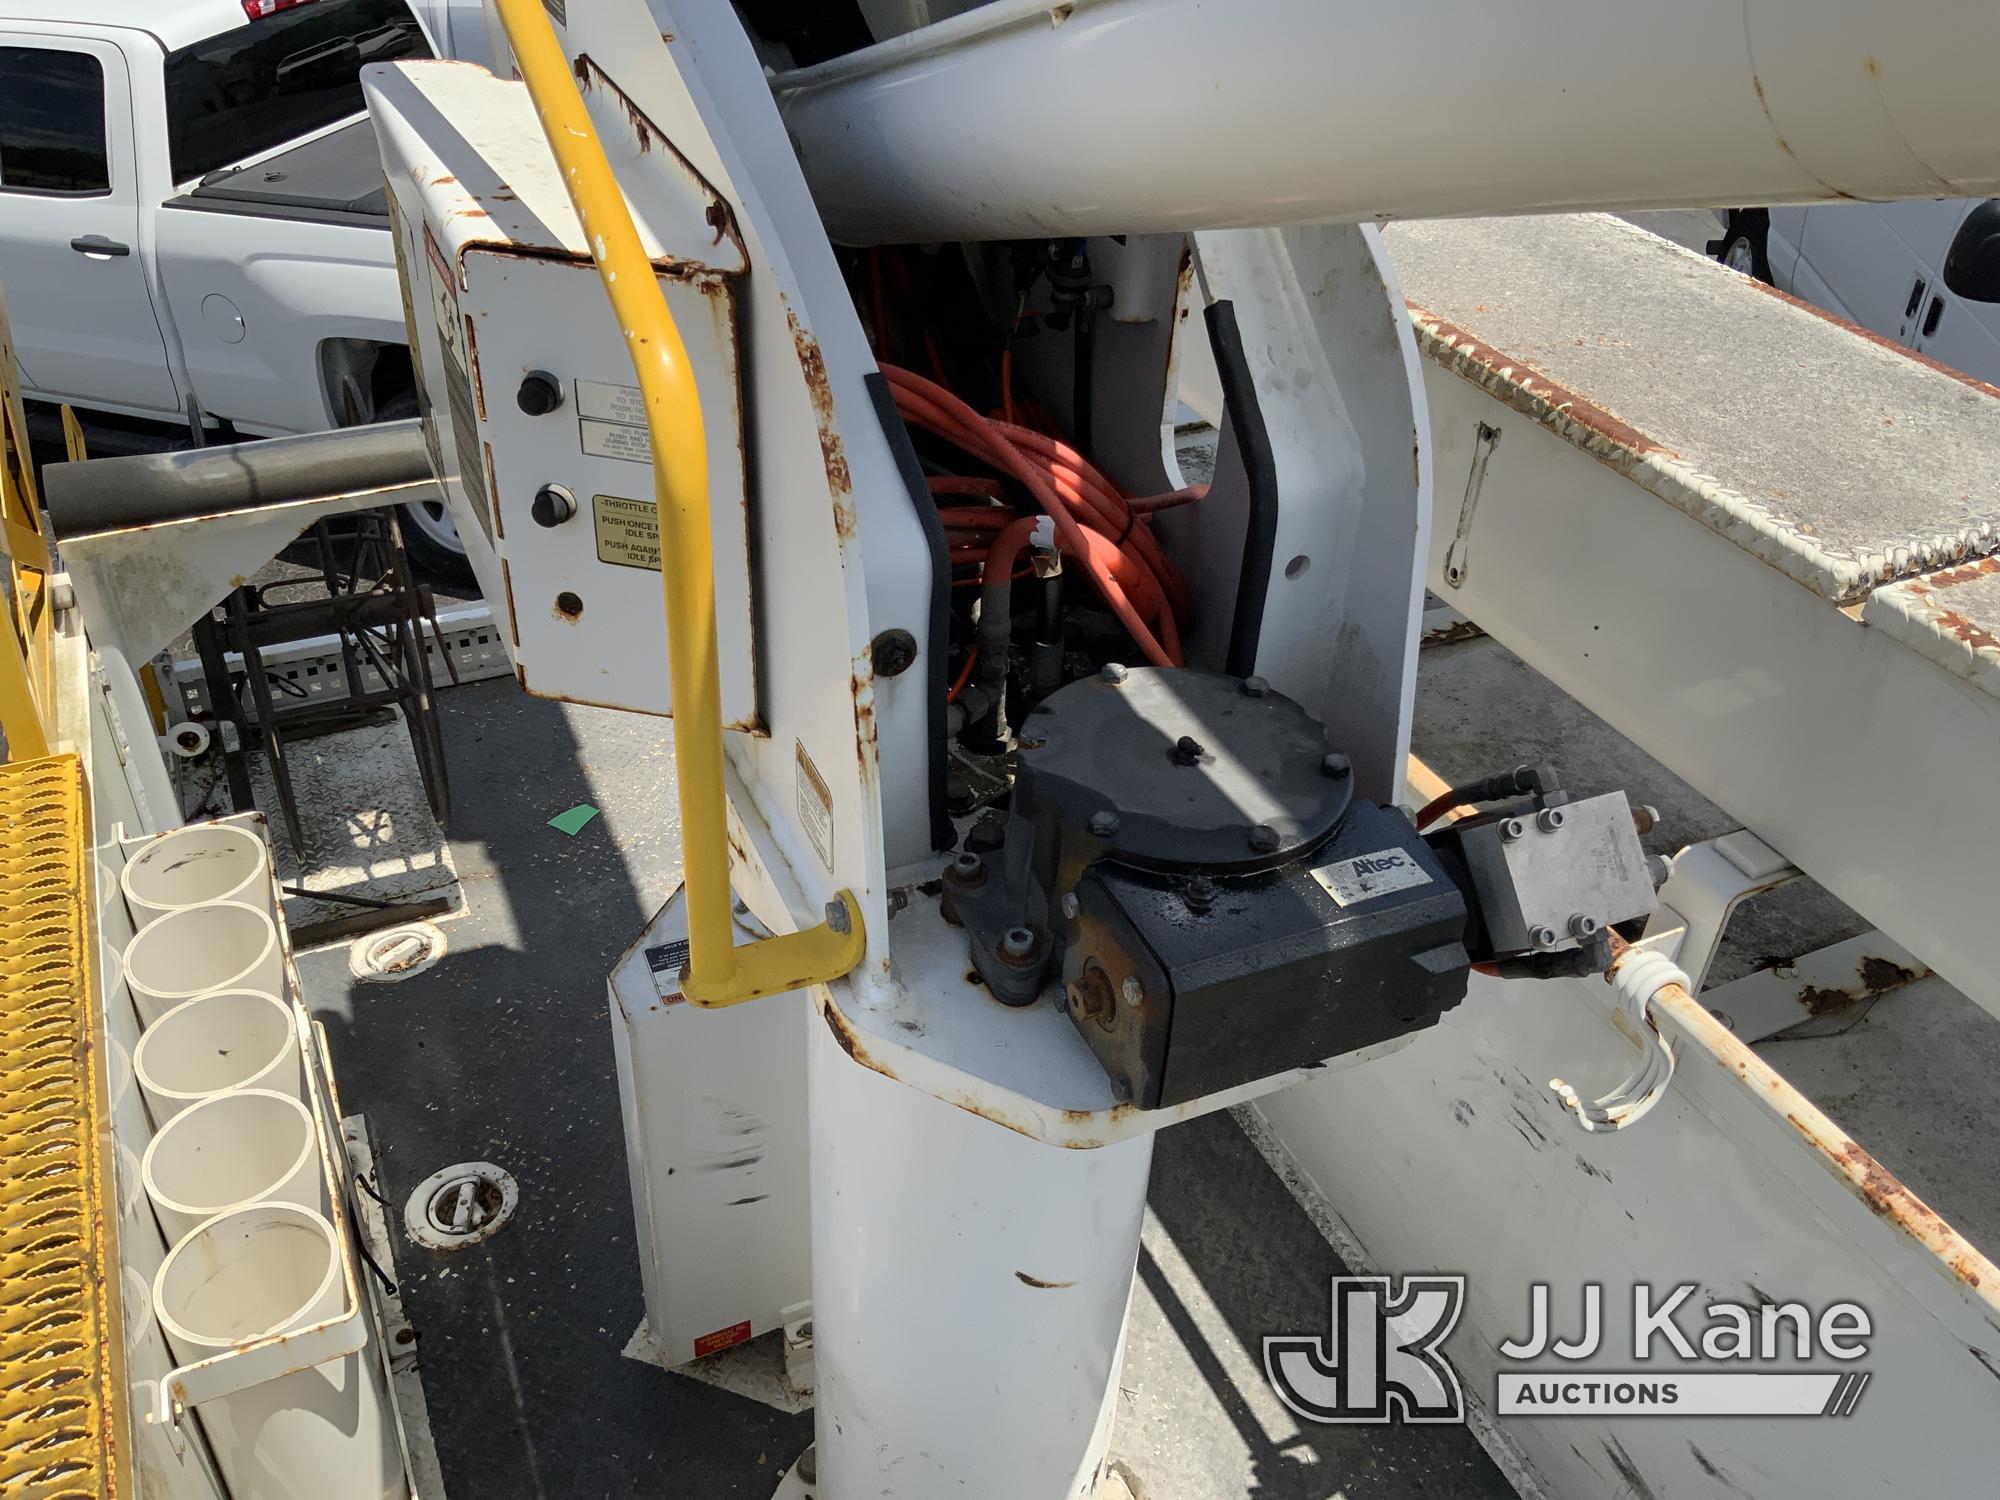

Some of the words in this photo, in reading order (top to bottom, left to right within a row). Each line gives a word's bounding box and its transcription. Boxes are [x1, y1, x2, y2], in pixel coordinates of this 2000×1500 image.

[602, 516, 626, 526] PUSH
[625, 528, 645, 539] IDLE
[604, 540, 628, 550] PUSH
[627, 552, 646, 562] IDLE
[1351, 856, 1405, 878] Altec
